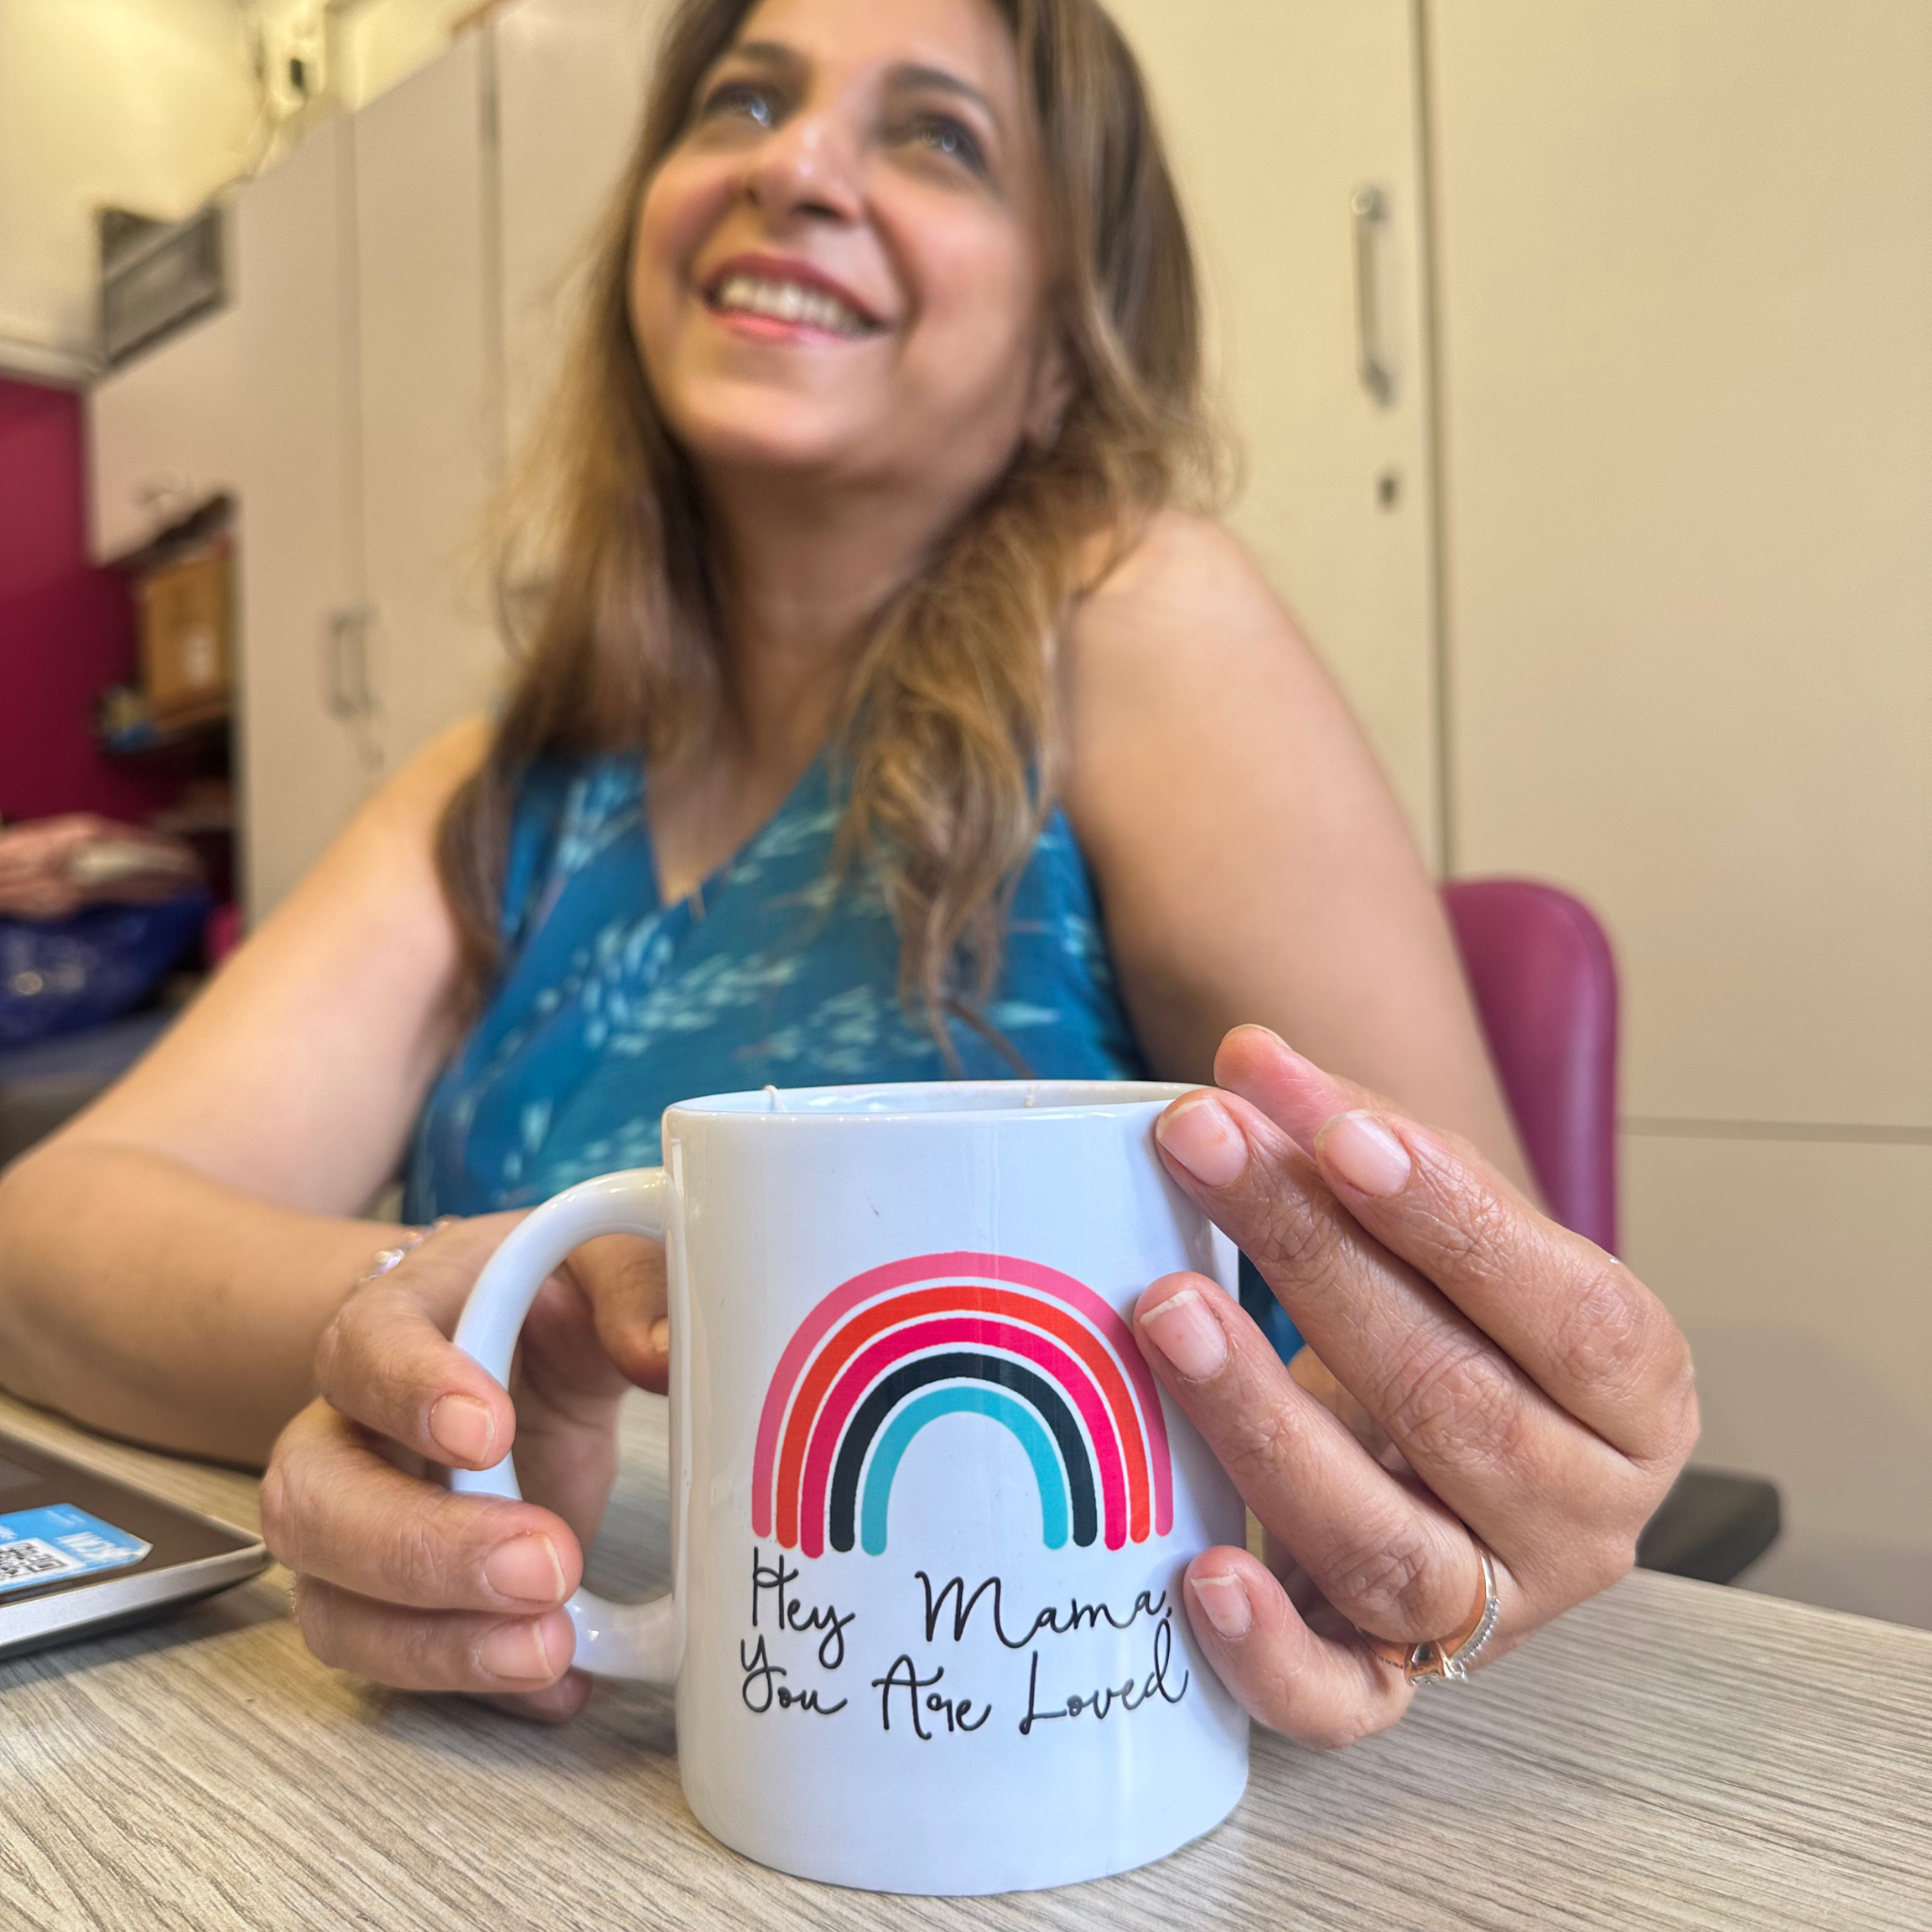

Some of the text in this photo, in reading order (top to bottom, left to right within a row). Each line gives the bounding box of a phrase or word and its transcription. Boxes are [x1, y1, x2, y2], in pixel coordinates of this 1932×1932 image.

[753, 1547, 1173, 1669] Hey Mama,
[741, 1617, 1190, 1740] You Are Loved
